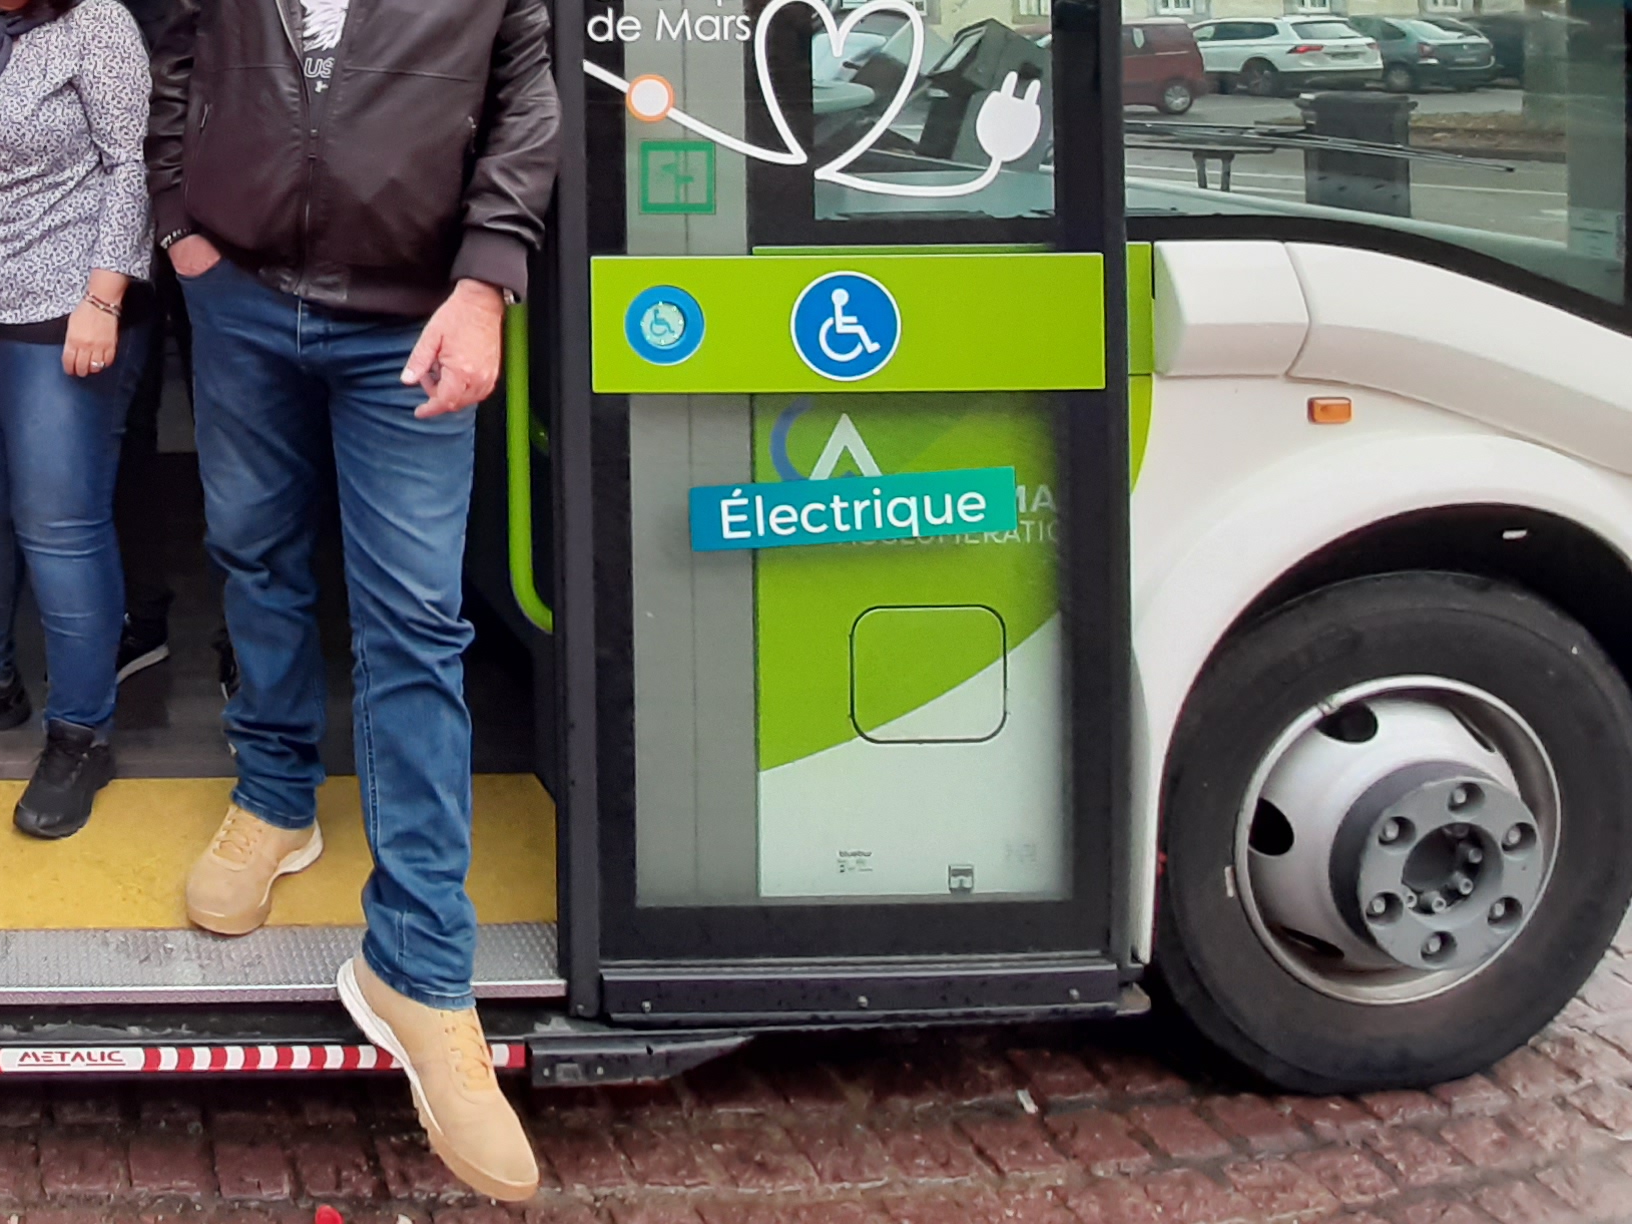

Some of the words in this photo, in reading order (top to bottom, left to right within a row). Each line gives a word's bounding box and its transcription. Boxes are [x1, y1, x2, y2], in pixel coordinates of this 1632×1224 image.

[586, 6, 642, 42] de
[655, 8, 752, 42] Mars
[719, 487, 988, 542] Électrique
[18, 1050, 124, 1063] METALIC
